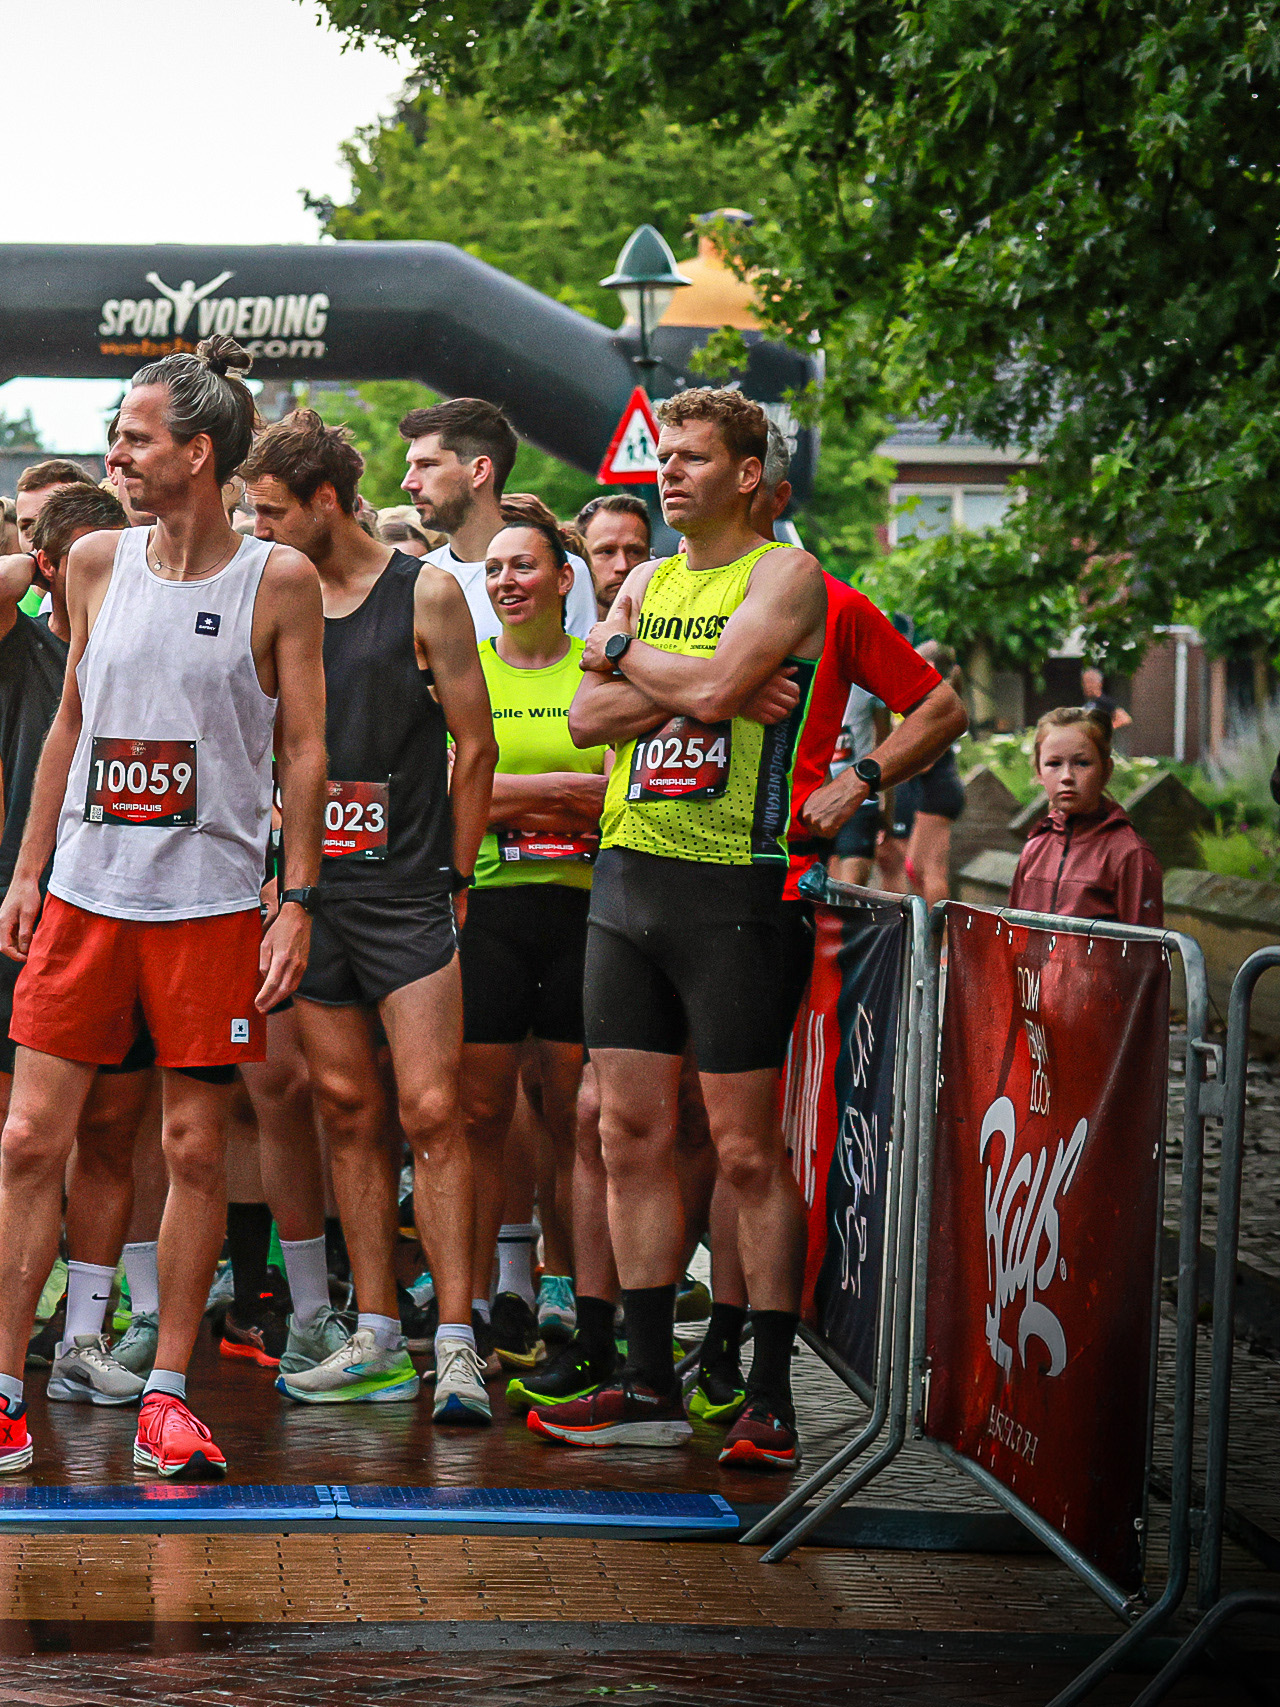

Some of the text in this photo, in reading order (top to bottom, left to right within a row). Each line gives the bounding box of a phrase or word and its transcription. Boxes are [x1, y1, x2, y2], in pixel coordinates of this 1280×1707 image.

[635, 737, 727, 771] 10254
[94, 759, 192, 796] 10059
[649, 778, 697, 787] KAMPHUIS
[112, 802, 162, 812] KAMPHUIS
[527, 843, 575, 851] KAMPHUIS
